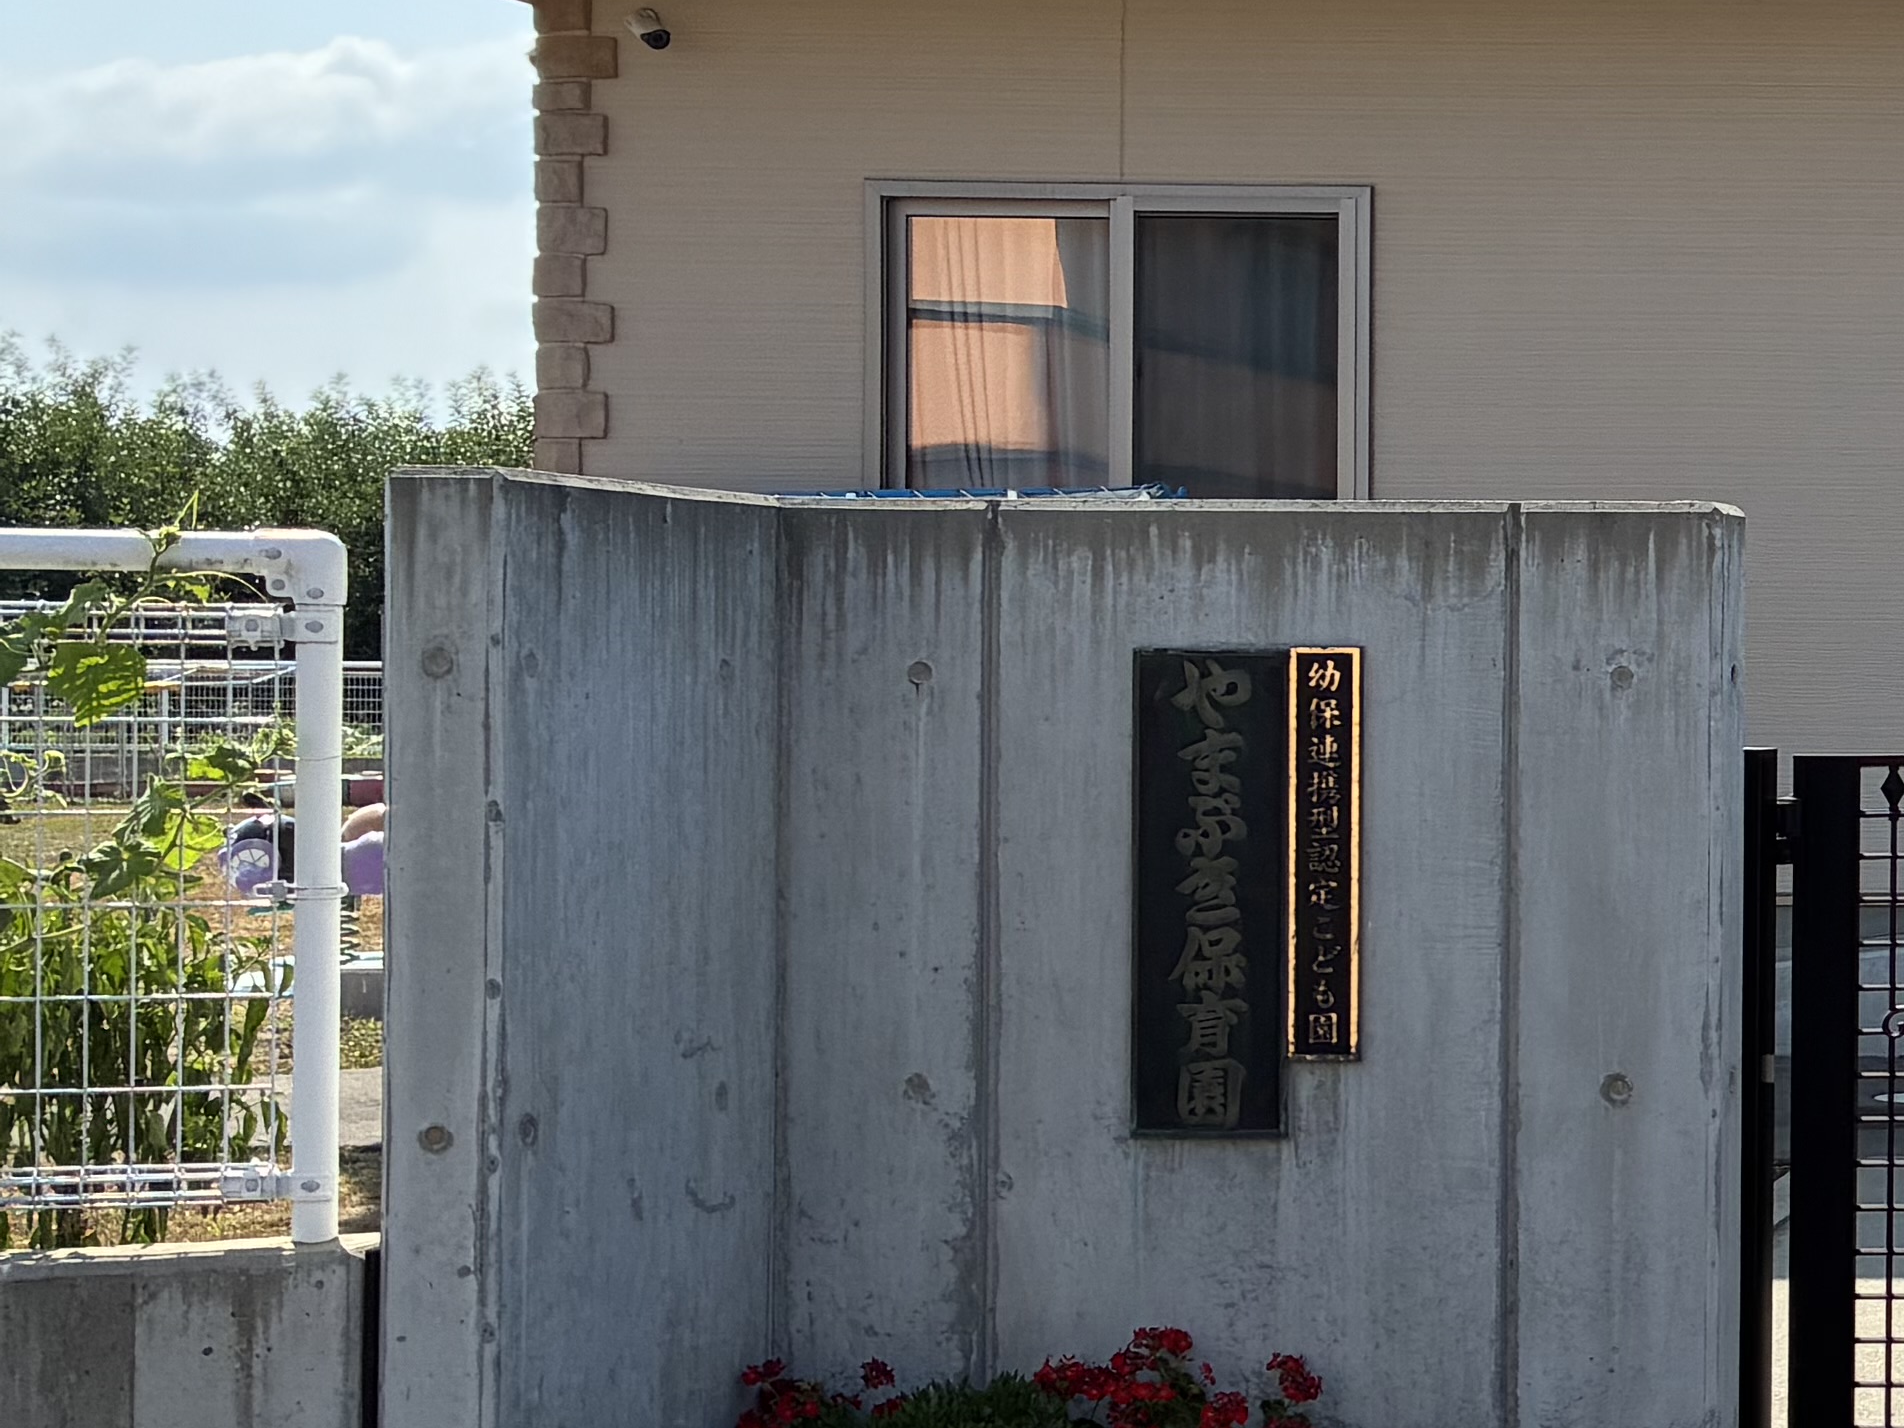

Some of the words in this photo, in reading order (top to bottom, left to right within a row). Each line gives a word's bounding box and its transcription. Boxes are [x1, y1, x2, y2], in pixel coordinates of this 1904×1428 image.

[1169, 658, 1252, 1129] やまぶき保育園
[1307, 660, 1344, 1045] 幼保連携型認定こども園
